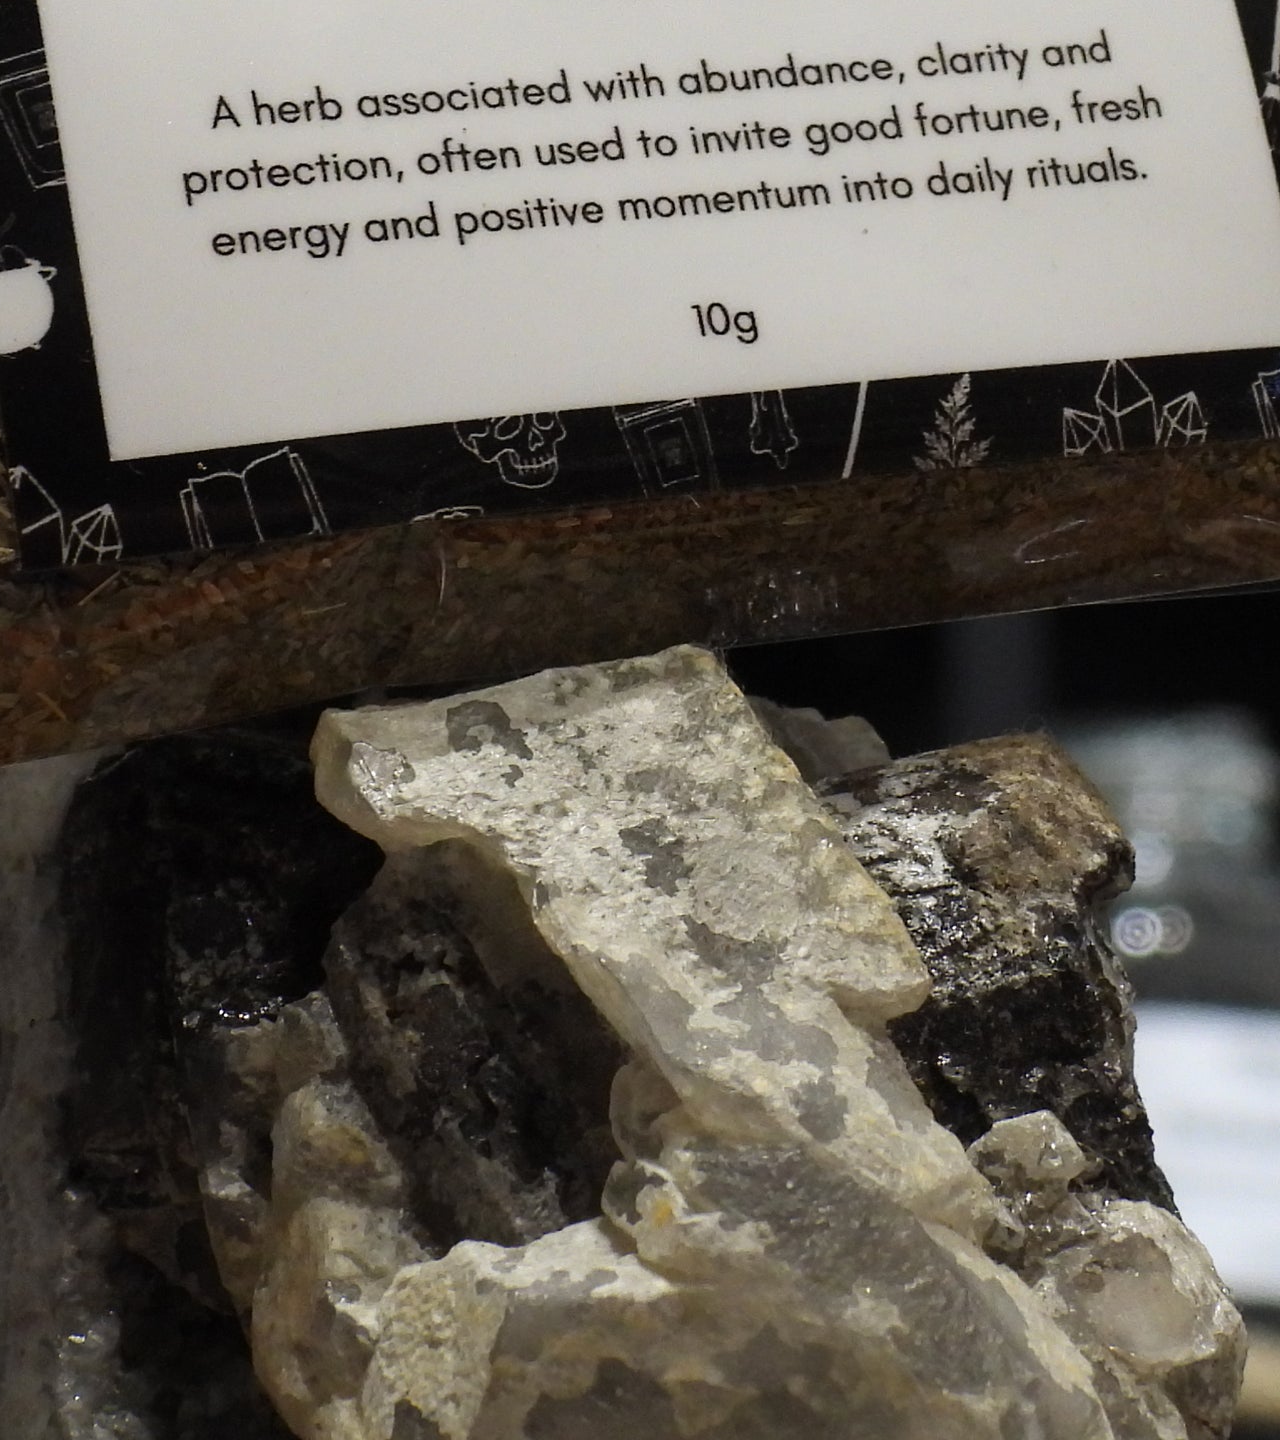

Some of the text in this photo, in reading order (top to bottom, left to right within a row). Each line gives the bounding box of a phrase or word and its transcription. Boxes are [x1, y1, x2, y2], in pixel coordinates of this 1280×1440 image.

[211, 28, 1112, 130] A herb associated with abundance, clarity and
[182, 84, 1163, 208] protection, often used to invite good fortune, fresh
[211, 146, 1148, 259] energy and positive momentum into daily rituals.
[690, 302, 759, 345] 10g
